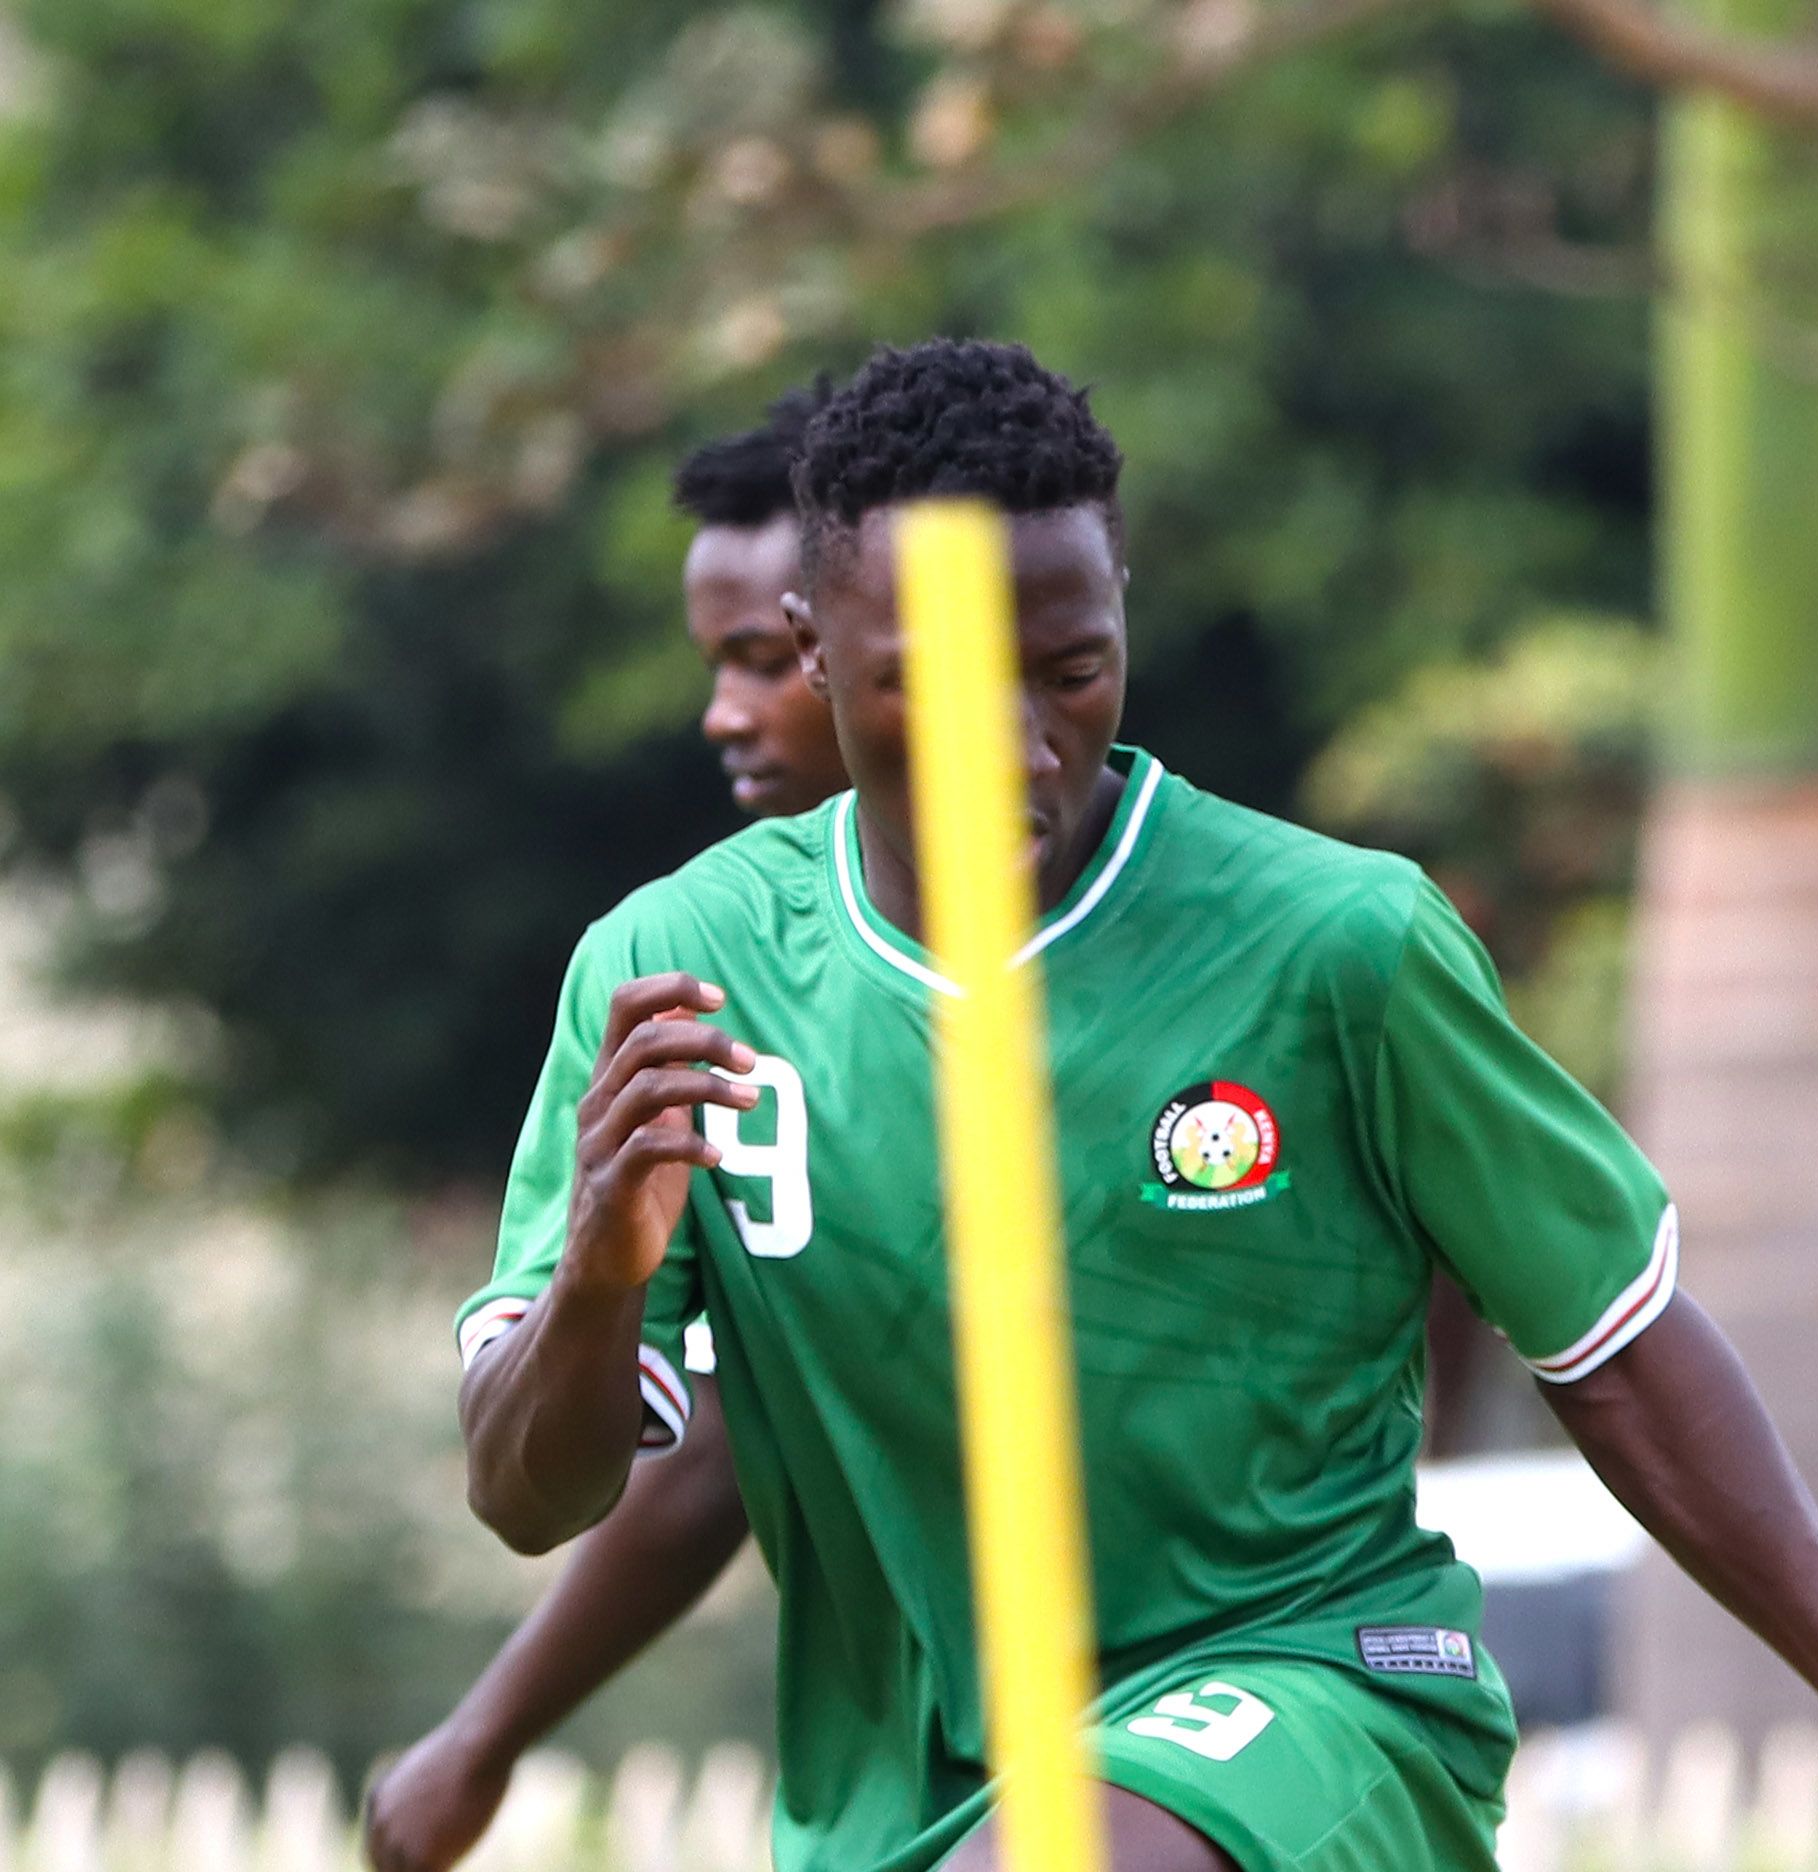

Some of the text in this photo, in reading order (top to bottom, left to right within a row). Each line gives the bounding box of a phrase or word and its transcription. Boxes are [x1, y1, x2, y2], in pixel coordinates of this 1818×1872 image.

[702, 1054, 815, 1259] 9
[1153, 1101, 1187, 1184] FOOTBALL
[1167, 1187, 1268, 1210] FEDERATION
[1126, 1681, 1276, 1762] 9
